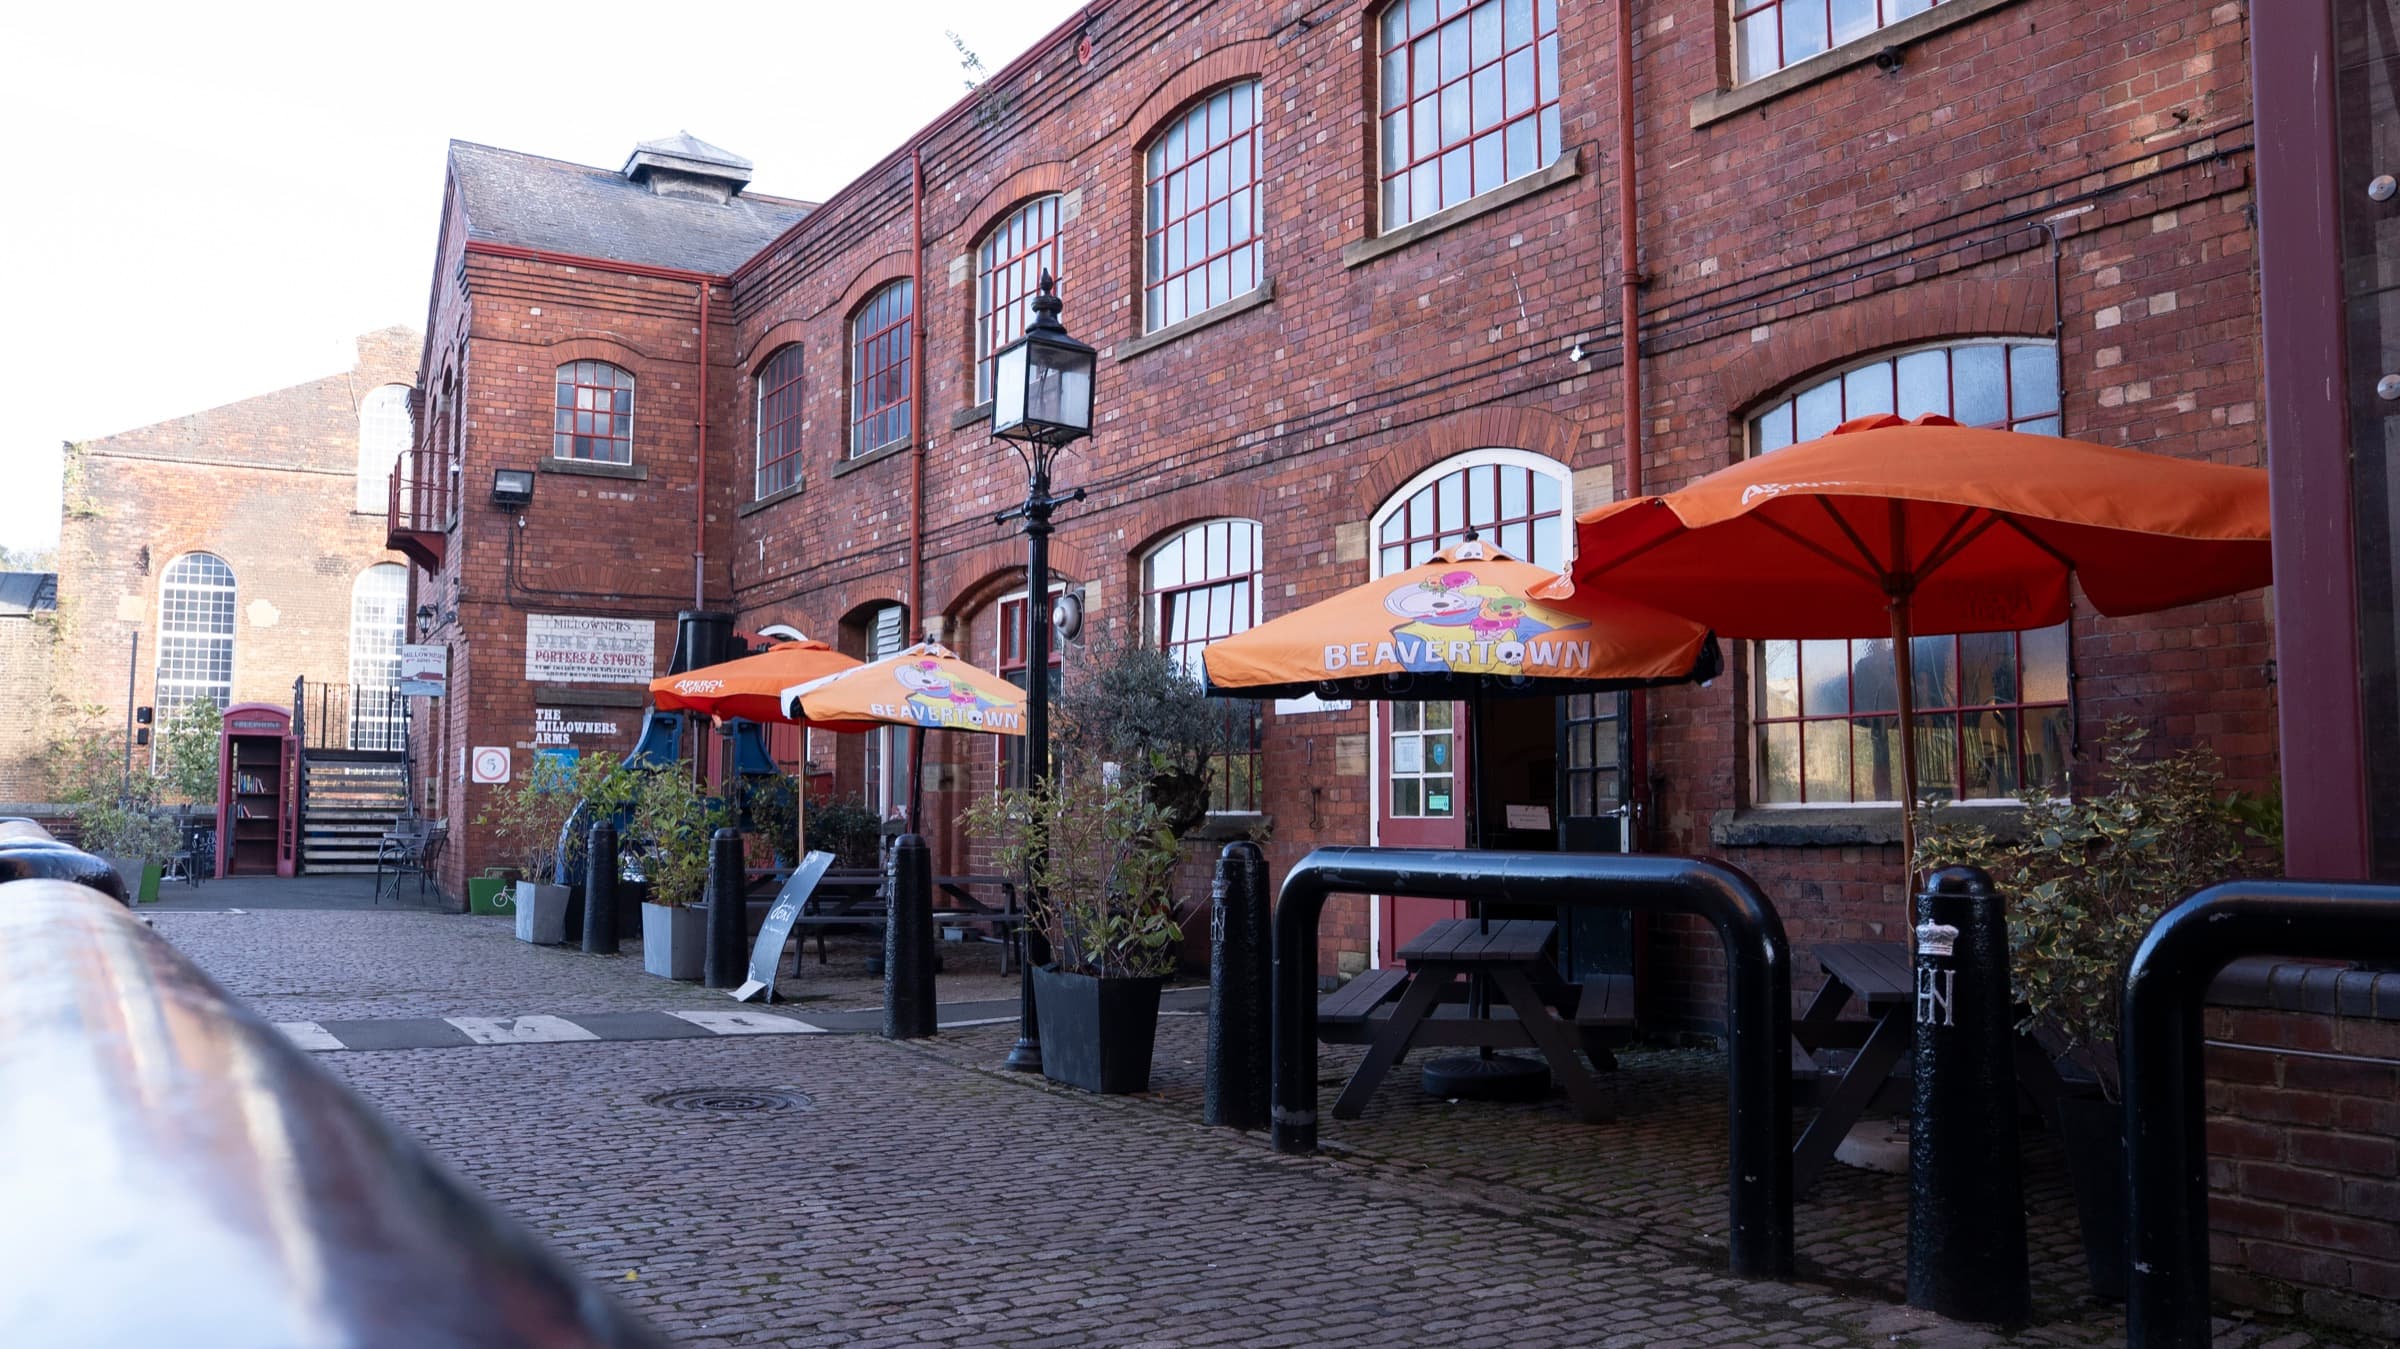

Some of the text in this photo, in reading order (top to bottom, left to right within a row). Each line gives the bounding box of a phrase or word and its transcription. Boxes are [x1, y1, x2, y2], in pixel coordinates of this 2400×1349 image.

[554, 618, 631, 632] MILLOWNERS
[535, 650, 646, 667] PORTERS & STOUTS
[1324, 640, 1590, 670] BEAVERTOWN
[675, 679, 725, 689] APEROL
[681, 686, 715, 696] SPRITZ
[536, 709, 561, 721] THE
[870, 703, 1018, 729] BEAVERTOWN
[536, 721, 617, 734] MILLOWNERS
[535, 733, 570, 745] ARMS
[487, 758, 497, 771] 5
